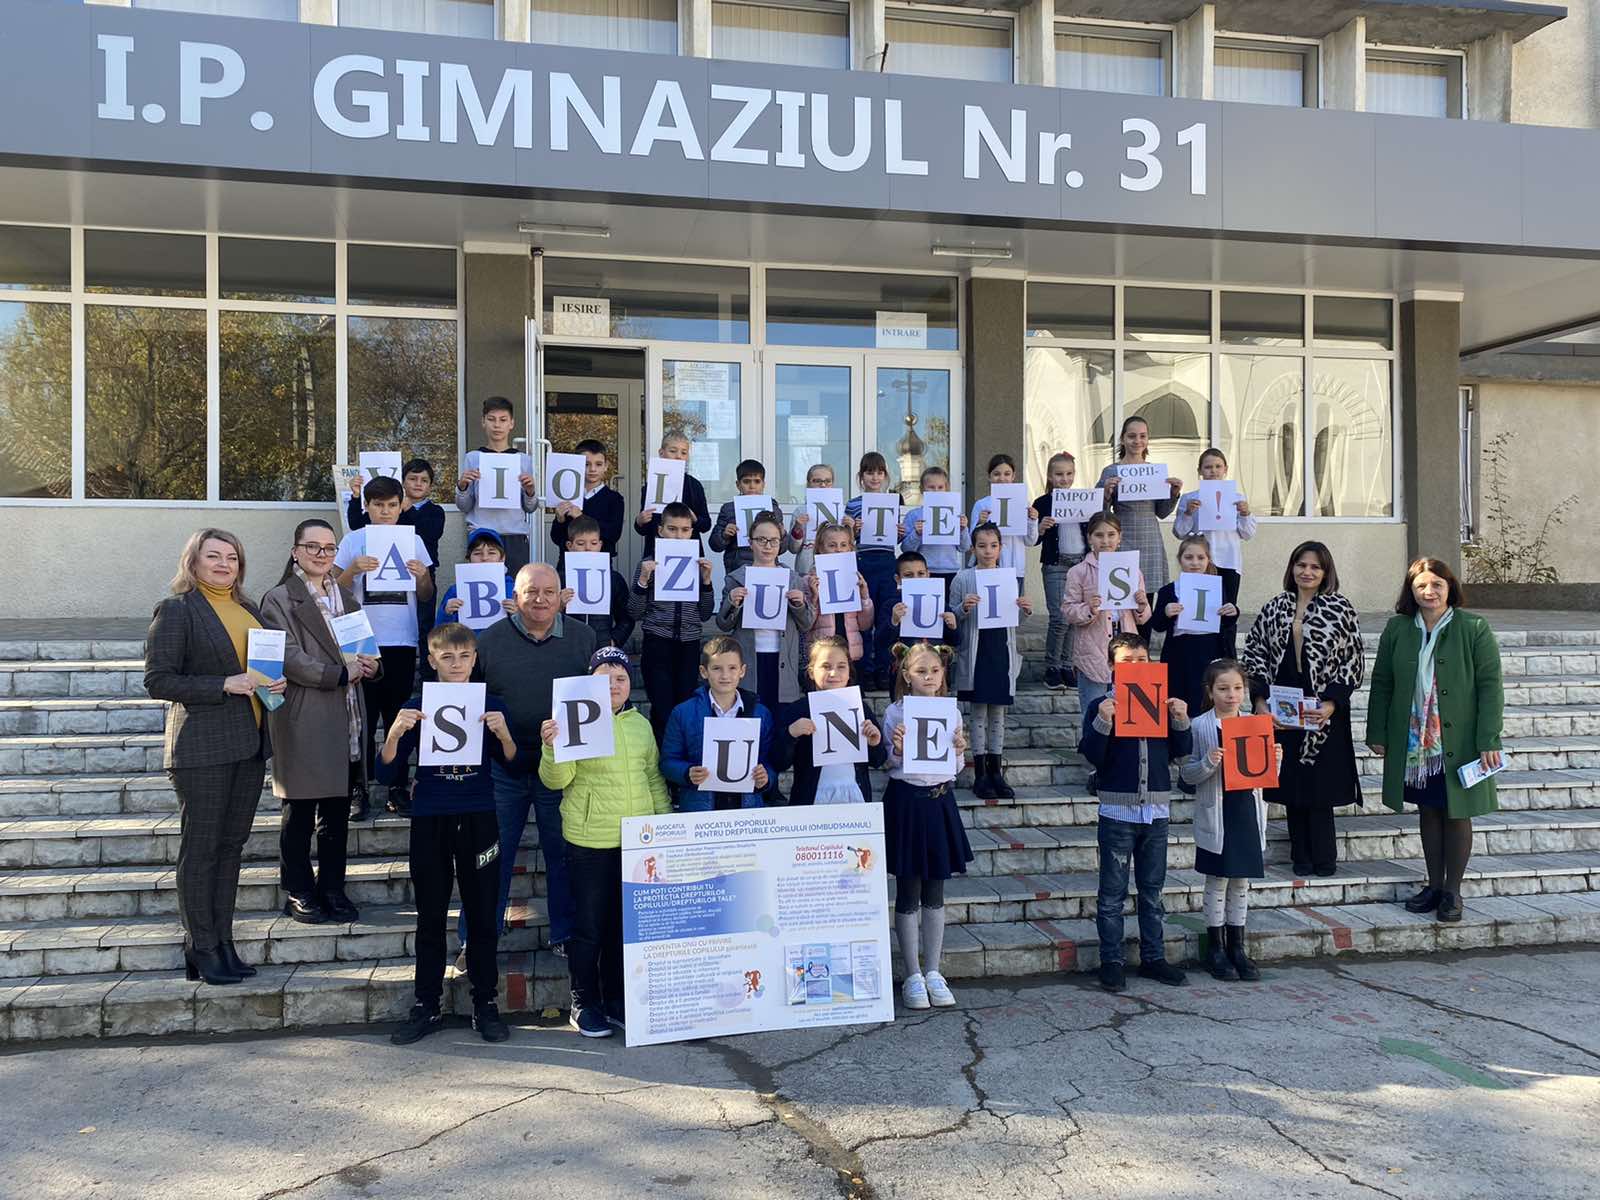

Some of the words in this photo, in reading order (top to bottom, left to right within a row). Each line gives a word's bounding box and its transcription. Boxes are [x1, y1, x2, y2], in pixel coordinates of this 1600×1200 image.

[312, 54, 929, 176] GIMNAZIUL
[963, 104, 1084, 188] Nr.
[1120, 117, 1207, 195] 31
[882, 328, 920, 338] INTRARE
[492, 467, 509, 499] I
[551, 468, 581, 500] O
[1121, 484, 1148, 494] LOR
[929, 505, 955, 536] E
[997, 497, 1012, 528] I
[1055, 508, 1085, 518] RIVA
[1214, 491, 1222, 521] !
[373, 542, 411, 581] A
[662, 555, 695, 592] Z
[464, 581, 501, 619] B
[573, 568, 606, 604] U
[752, 583, 785, 620] U
[824, 569, 855, 605] L
[983, 584, 1001, 620] I
[908, 593, 941, 629] U
[1192, 588, 1209, 622] I
[1122, 683, 1162, 727] N
[431, 704, 468, 753] S
[561, 699, 602, 748] P
[819, 707, 861, 754] N
[912, 717, 949, 762] E
[713, 739, 755, 783] U
[1232, 735, 1270, 778] U
[695, 821, 733, 831] AVOCATUL
[734, 818, 777, 827] POPORULUI
[695, 830, 724, 838] PENTRU
[725, 826, 769, 836] DREPTURILE
[770, 824, 807, 833] COPILULUI
[809, 821, 871, 832] (OMBUDSMANUL)
[633, 889, 650, 897] CUM
